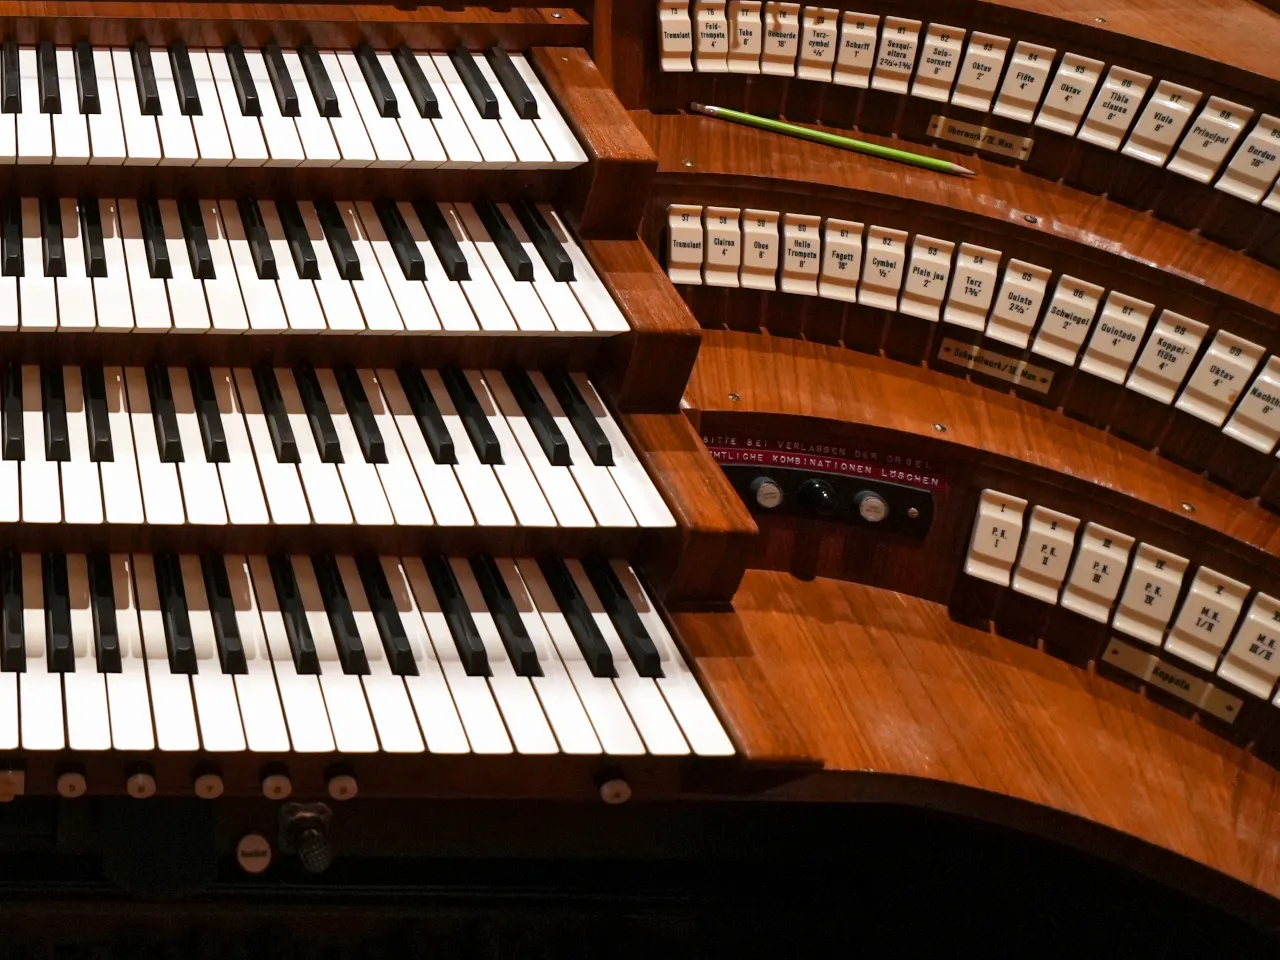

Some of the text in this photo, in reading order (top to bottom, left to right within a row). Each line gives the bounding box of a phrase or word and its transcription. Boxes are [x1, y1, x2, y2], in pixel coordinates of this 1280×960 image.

[1017, 72, 1034, 82] Flöte
[1061, 84, 1081, 95] Oktav
[1155, 112, 1173, 124] Viola
[1193, 126, 1229, 144] Principal
[754, 241, 768, 249] Oboe
[795, 240, 810, 248] Helle
[832, 251, 853, 261] Fagott
[967, 277, 982, 287] Terz
[1022, 273, 1032, 281] 65
[1008, 292, 1032, 305] Quinte
[1051, 306, 1089, 326] Schwiegel
[1122, 306, 1133, 315] 67
[1101, 323, 1136, 342] Quintade
[1157, 338, 1189, 355] Koppel-
[1157, 350, 1177, 363] flöte
[1209, 365, 1234, 380] Oktav
[704, 436, 736, 445] BITTE
[747, 439, 767, 447] BEI
[778, 441, 845, 455] VERLASSEN
[855, 450, 877, 460] DER
[709, 451, 763, 461] MTLICHE
[772, 455, 872, 473] KOMBINATIONEN
